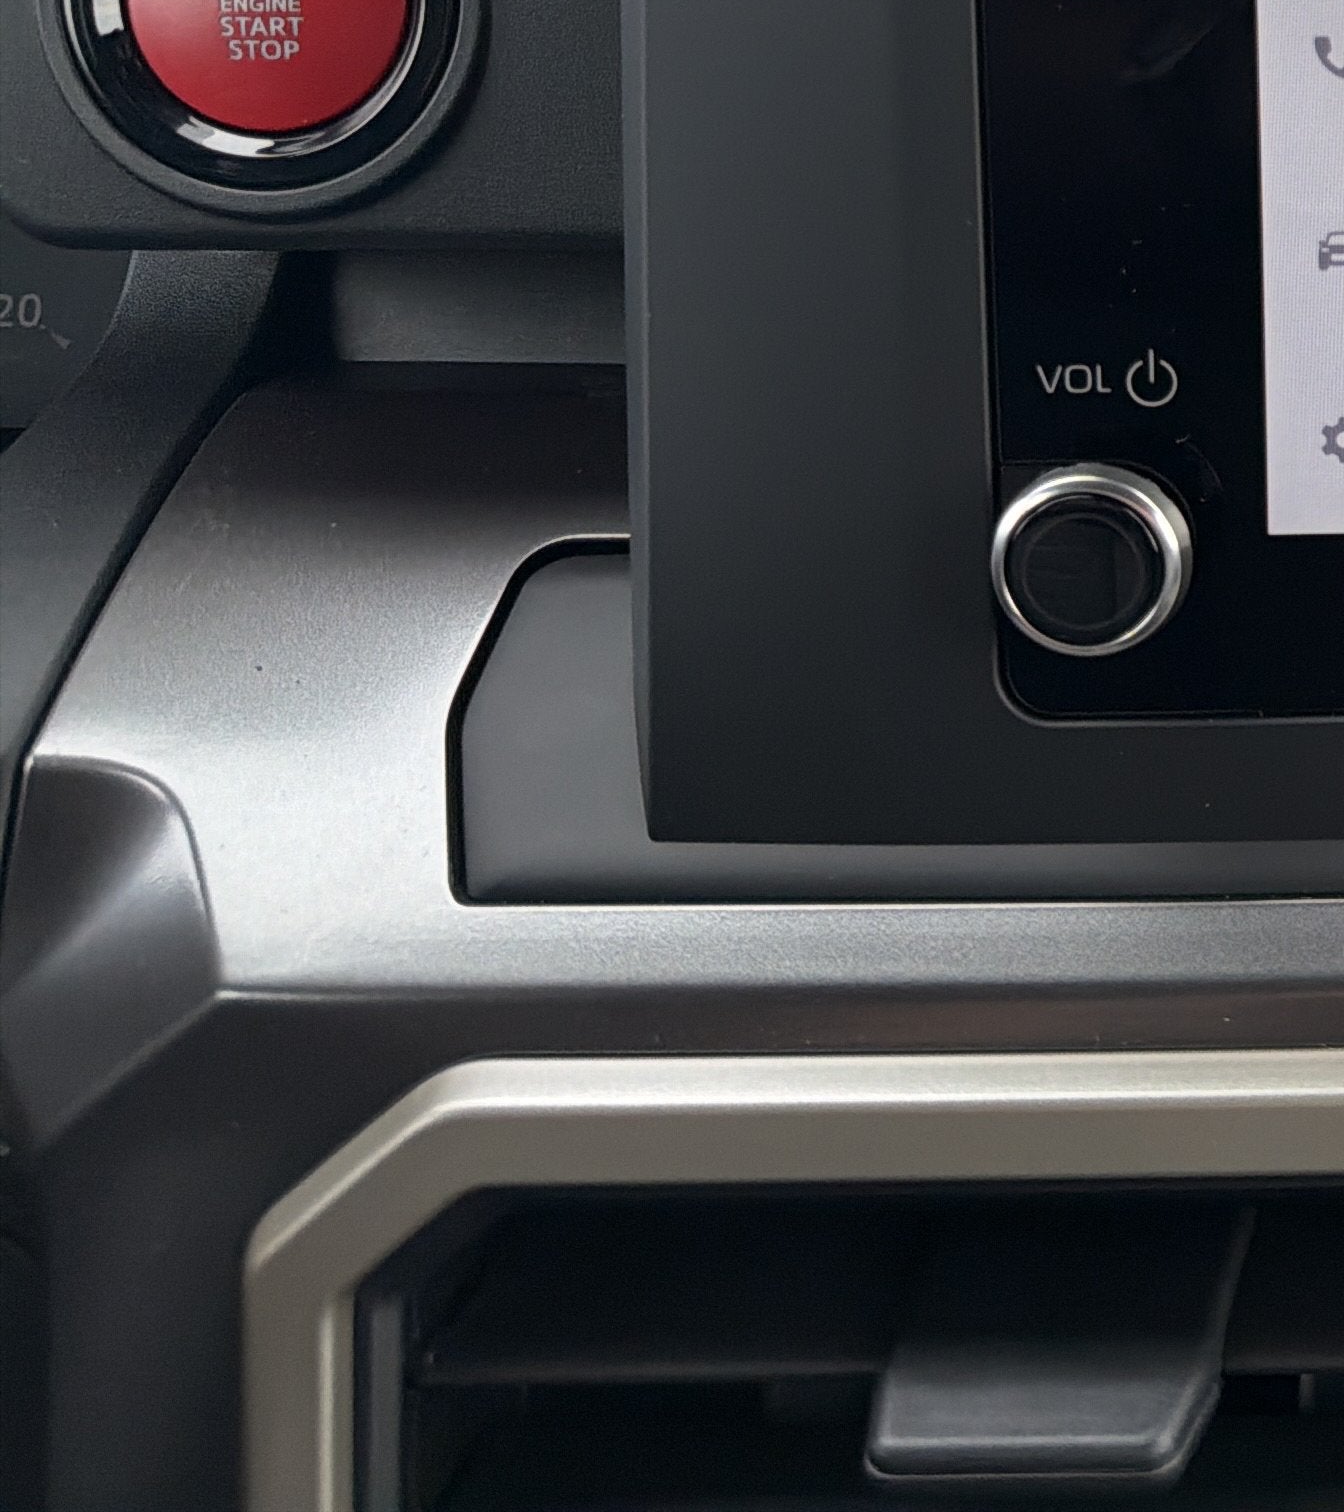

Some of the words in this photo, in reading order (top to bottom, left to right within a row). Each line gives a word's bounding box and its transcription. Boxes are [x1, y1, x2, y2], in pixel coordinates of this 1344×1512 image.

[220, 16, 304, 37] START
[229, 40, 300, 61] STOP
[1036, 364, 1112, 393] VOL
